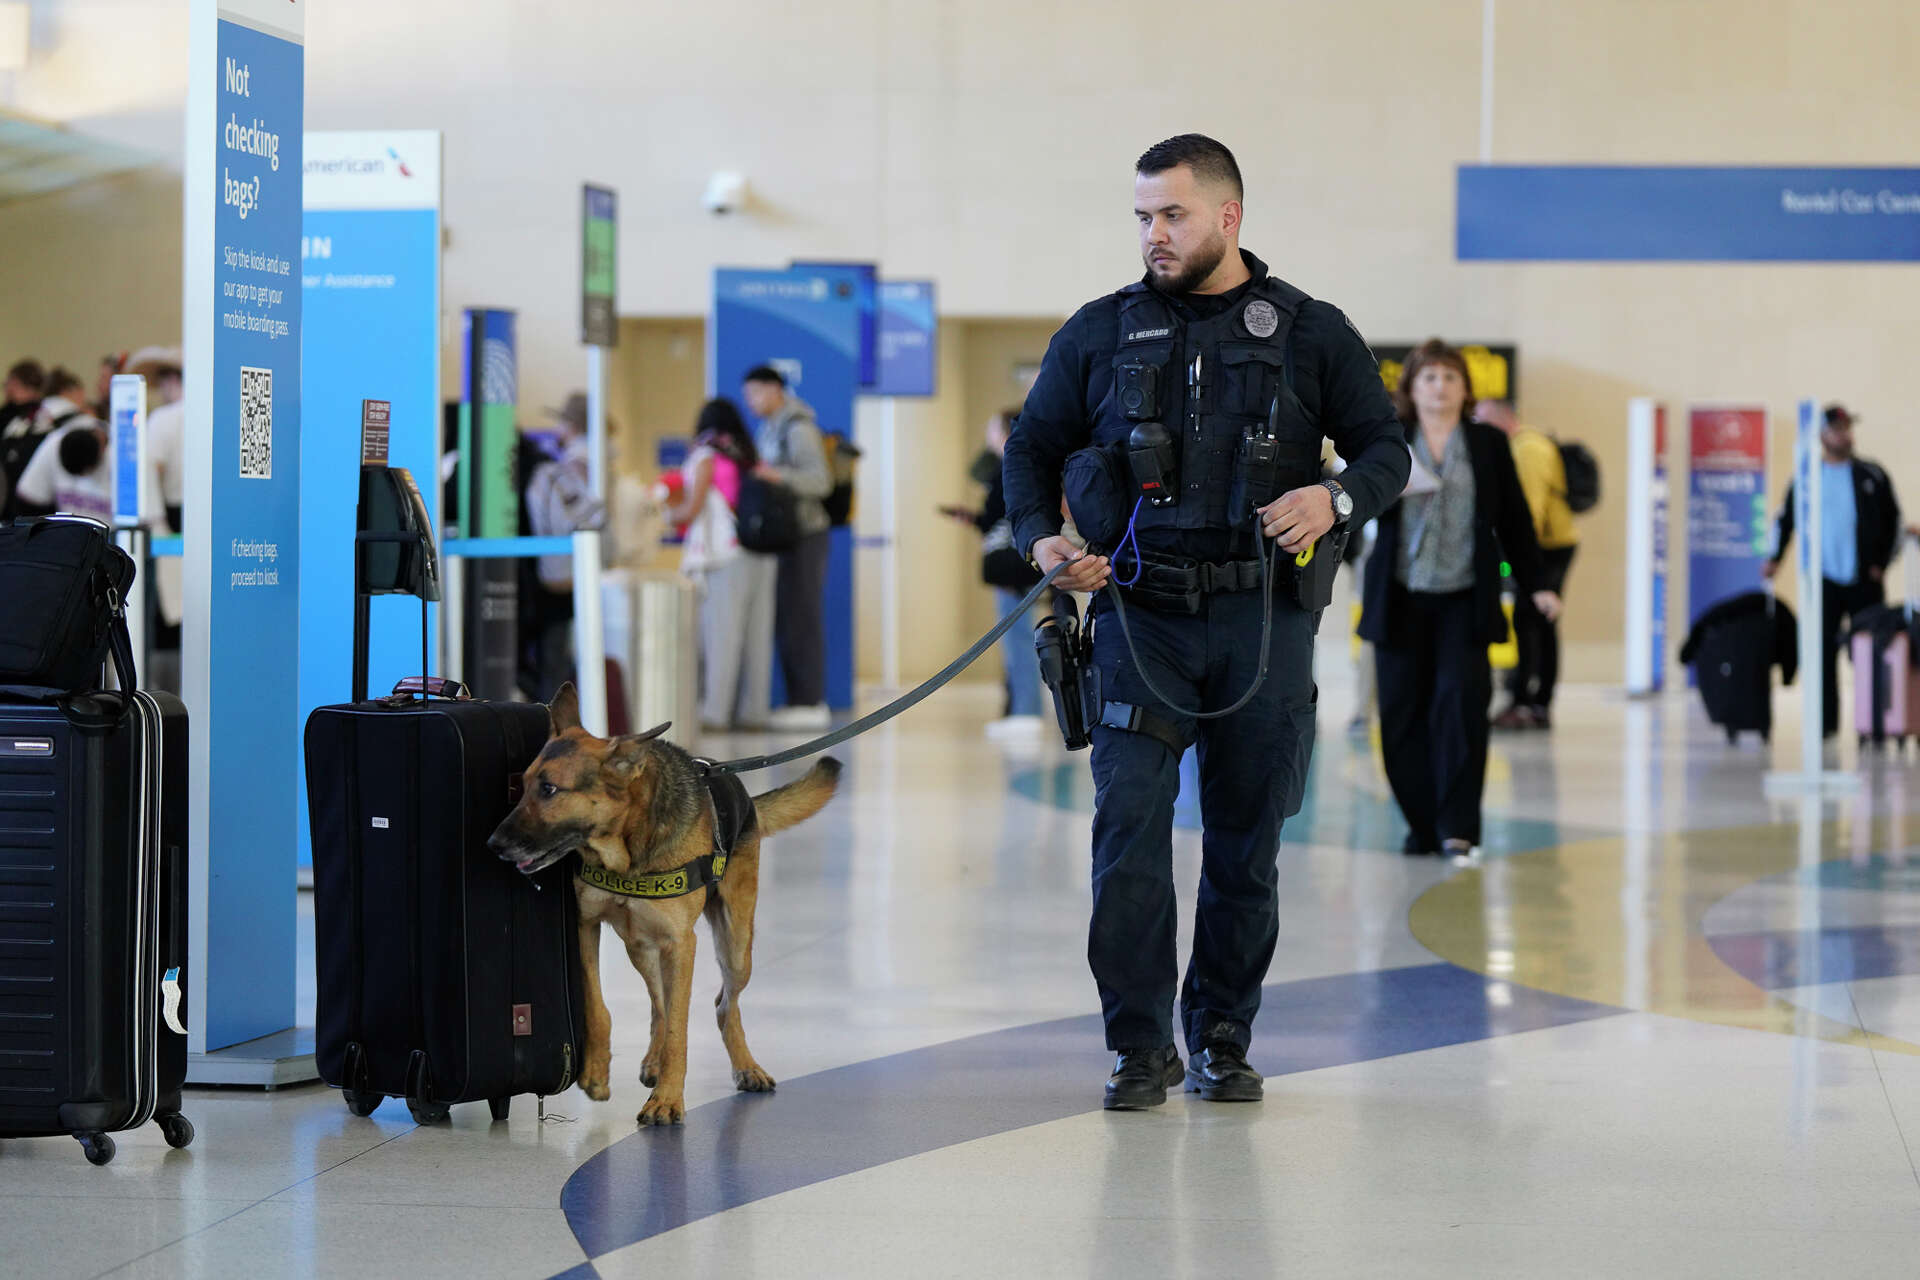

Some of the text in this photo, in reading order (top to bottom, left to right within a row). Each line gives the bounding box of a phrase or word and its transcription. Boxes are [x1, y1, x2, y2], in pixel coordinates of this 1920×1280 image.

[226, 57, 249, 97] Not
[225, 113, 279, 171] checking
[224, 168, 259, 219] bags?
[224, 246, 290, 276] Skip the kiosk and use
[224, 281, 283, 309] our app to get your
[224, 310, 246, 330] mobile
[247, 312, 275, 340] boarding
[1135, 329, 1168, 338] MERCADO
[231, 538, 237, 557] If
[238, 539, 264, 563] checking
[231, 567, 256, 591] proceed
[257, 571, 264, 585] to
[583, 864, 684, 893] POLICE K-9
